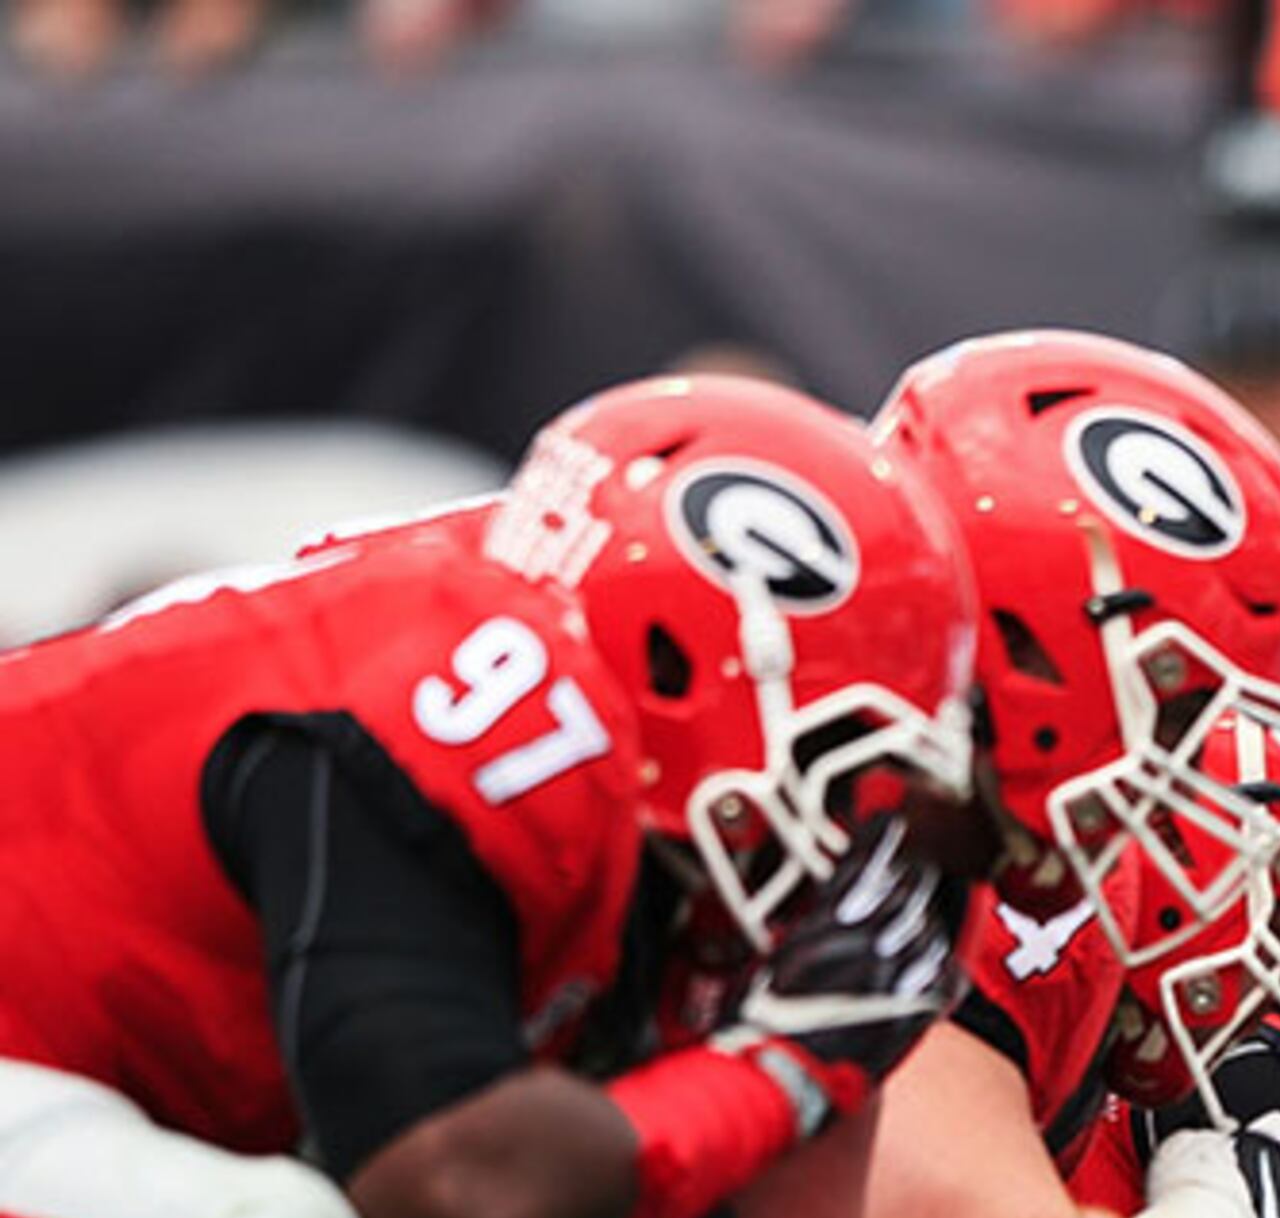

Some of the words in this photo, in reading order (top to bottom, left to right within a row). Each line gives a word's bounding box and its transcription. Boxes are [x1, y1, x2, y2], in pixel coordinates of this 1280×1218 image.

[672, 464, 854, 608] G
[1072, 412, 1240, 552] G
[412, 616, 611, 806] 97
